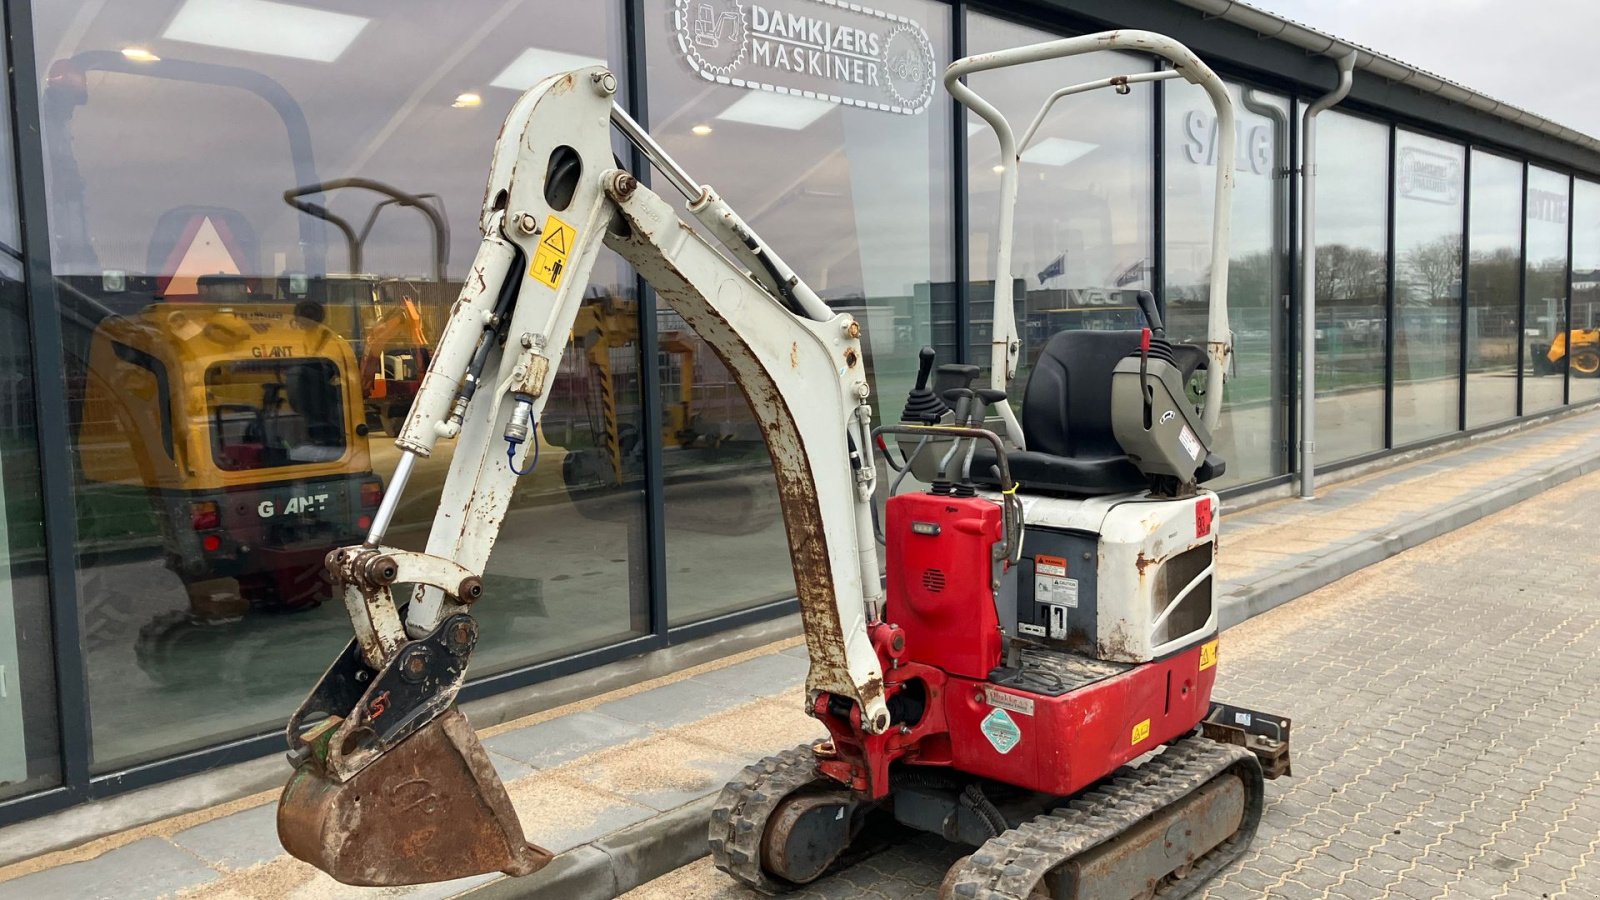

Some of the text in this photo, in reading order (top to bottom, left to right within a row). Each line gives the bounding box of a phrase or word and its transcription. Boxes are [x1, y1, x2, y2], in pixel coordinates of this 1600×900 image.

[752, 4, 880, 56] DAMKJÆRS
[752, 38, 880, 87] MASKINER
[252, 344, 293, 358] GIANT
[257, 493, 329, 518] GIANT
